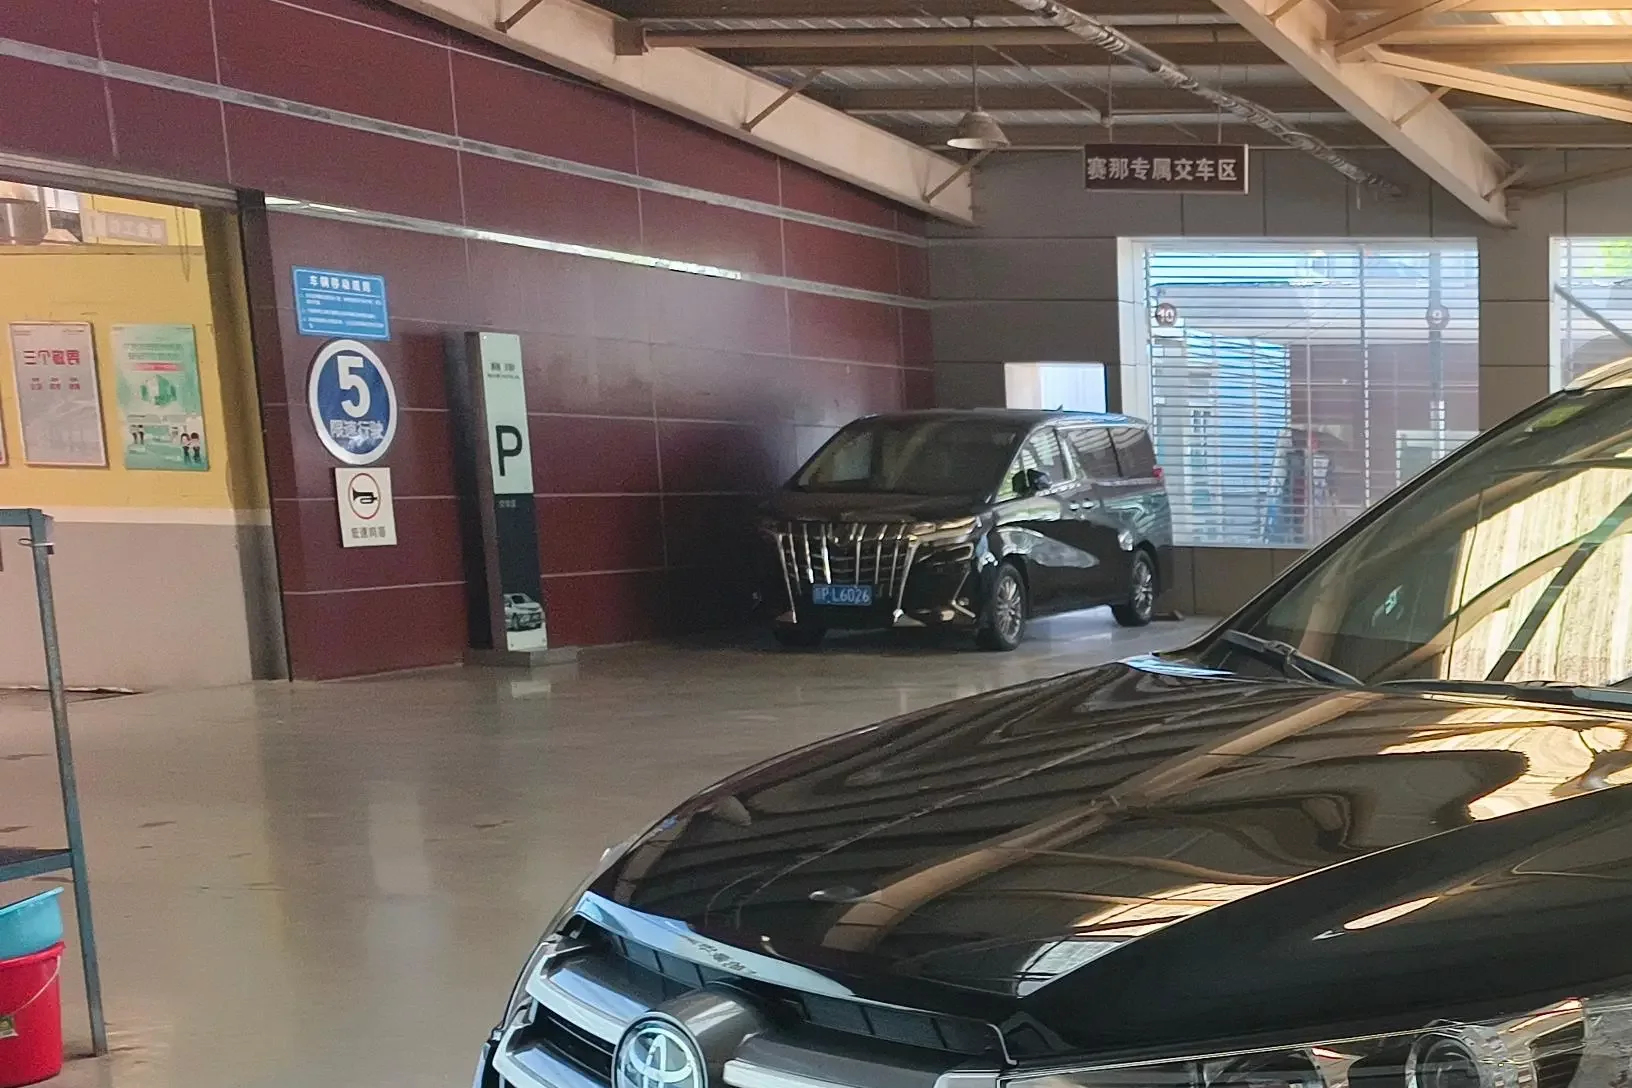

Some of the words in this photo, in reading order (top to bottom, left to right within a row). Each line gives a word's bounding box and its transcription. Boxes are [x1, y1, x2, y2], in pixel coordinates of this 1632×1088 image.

[1087, 156, 1237, 182] 赛那专属交车区
[1157, 309, 1175, 323] 10
[337, 355, 371, 418] 5
[495, 425, 523, 477] P
